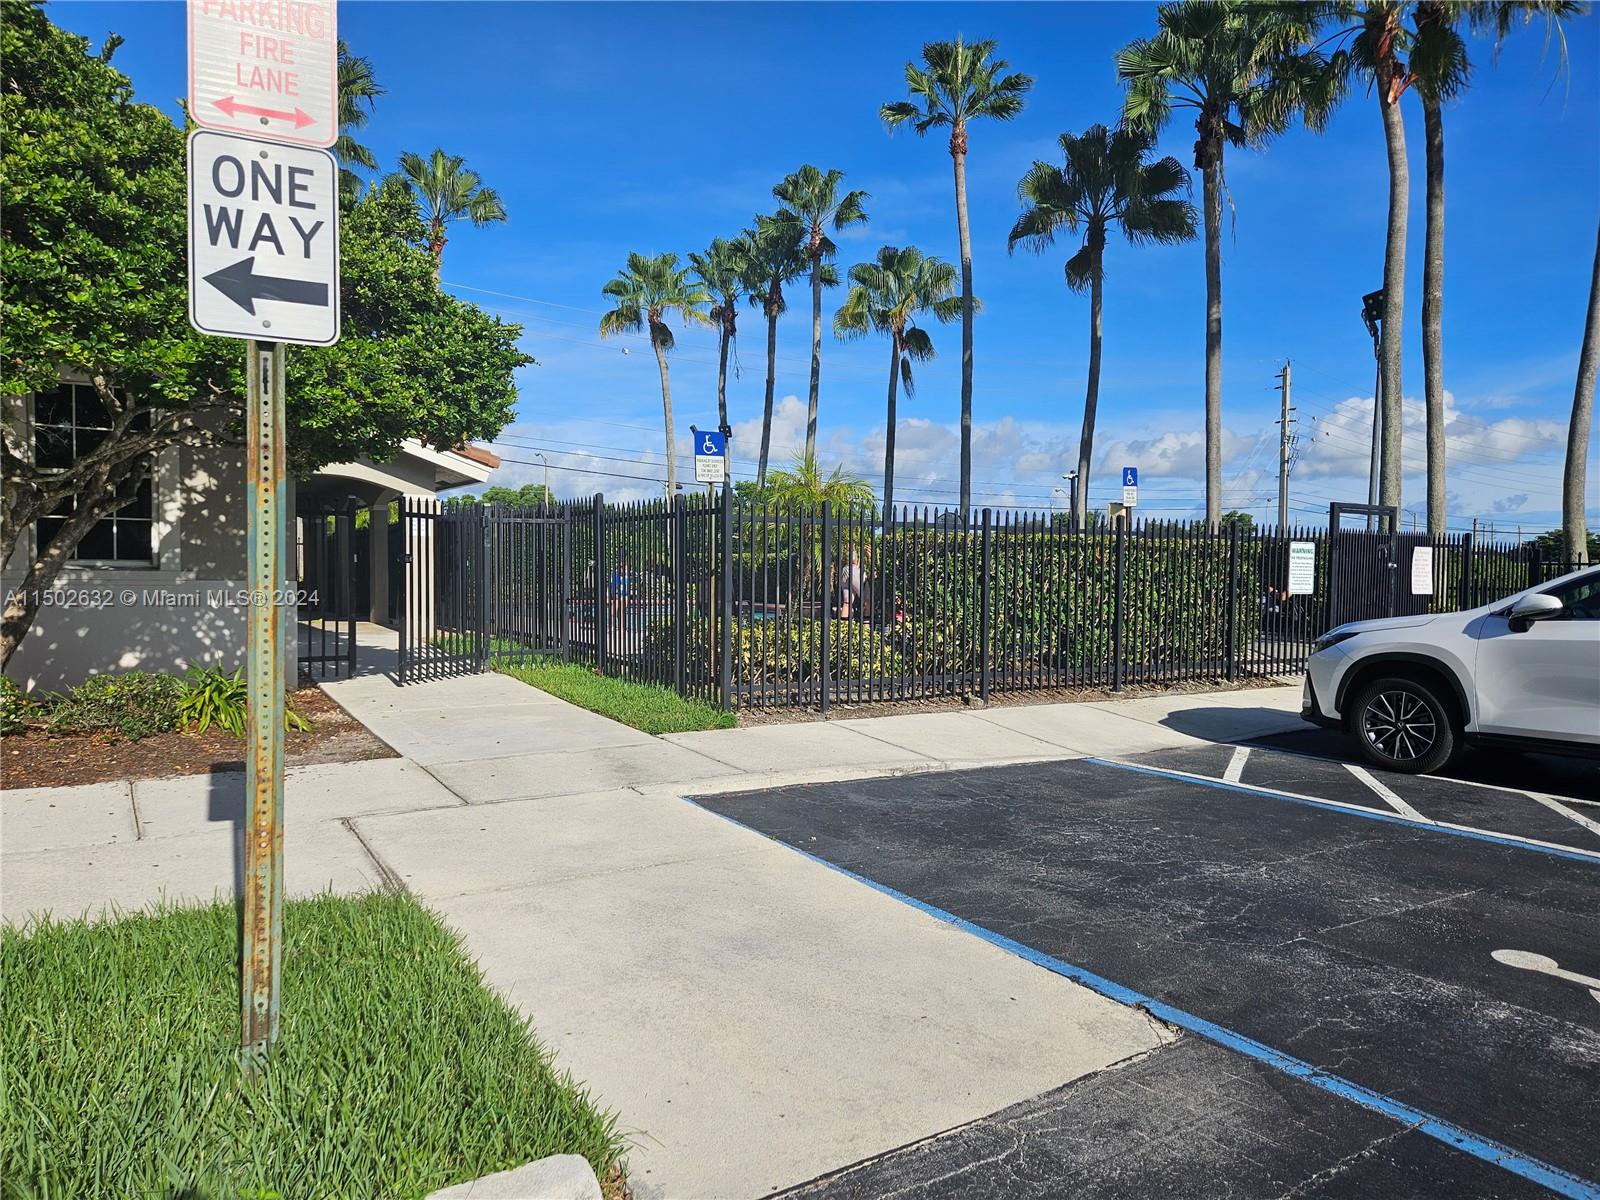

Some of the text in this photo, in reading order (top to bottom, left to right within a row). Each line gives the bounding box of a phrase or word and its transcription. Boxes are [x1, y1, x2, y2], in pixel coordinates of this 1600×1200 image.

[240, 31, 295, 65] FIRE
[236, 62, 299, 97] LANE
[212, 154, 316, 210] ONE
[203, 203, 324, 259] WAY
